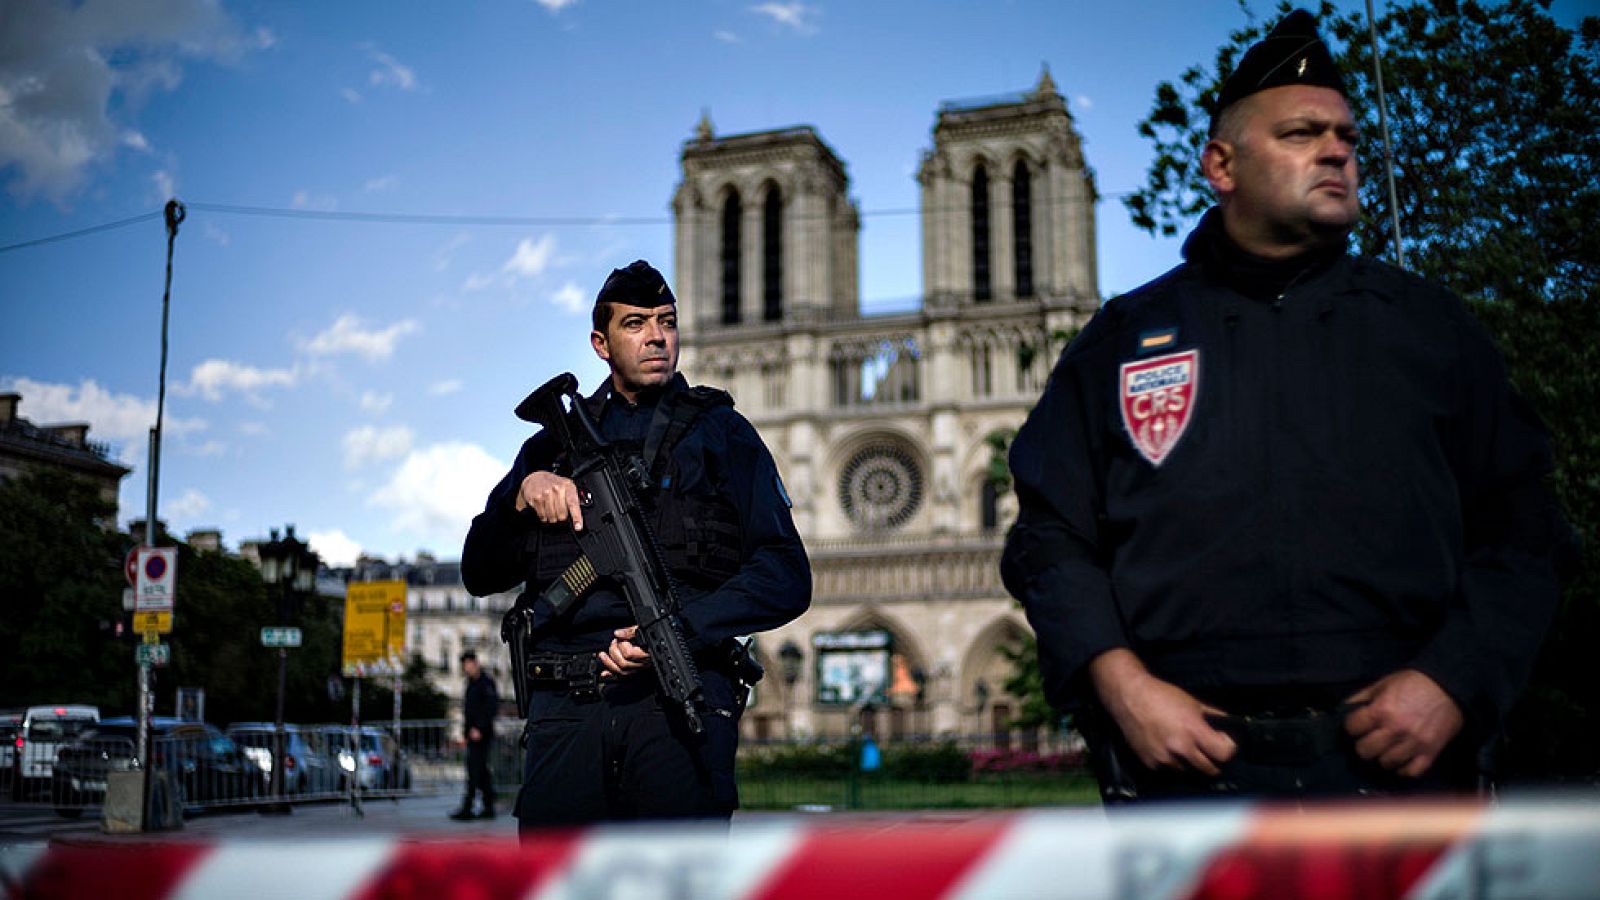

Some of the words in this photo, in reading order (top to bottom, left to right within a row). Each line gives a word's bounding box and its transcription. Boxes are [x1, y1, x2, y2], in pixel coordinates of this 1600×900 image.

[1130, 373, 1188, 393] NATIONALE
[1134, 365, 1183, 383] POLICE
[1132, 386, 1185, 419] CRS
